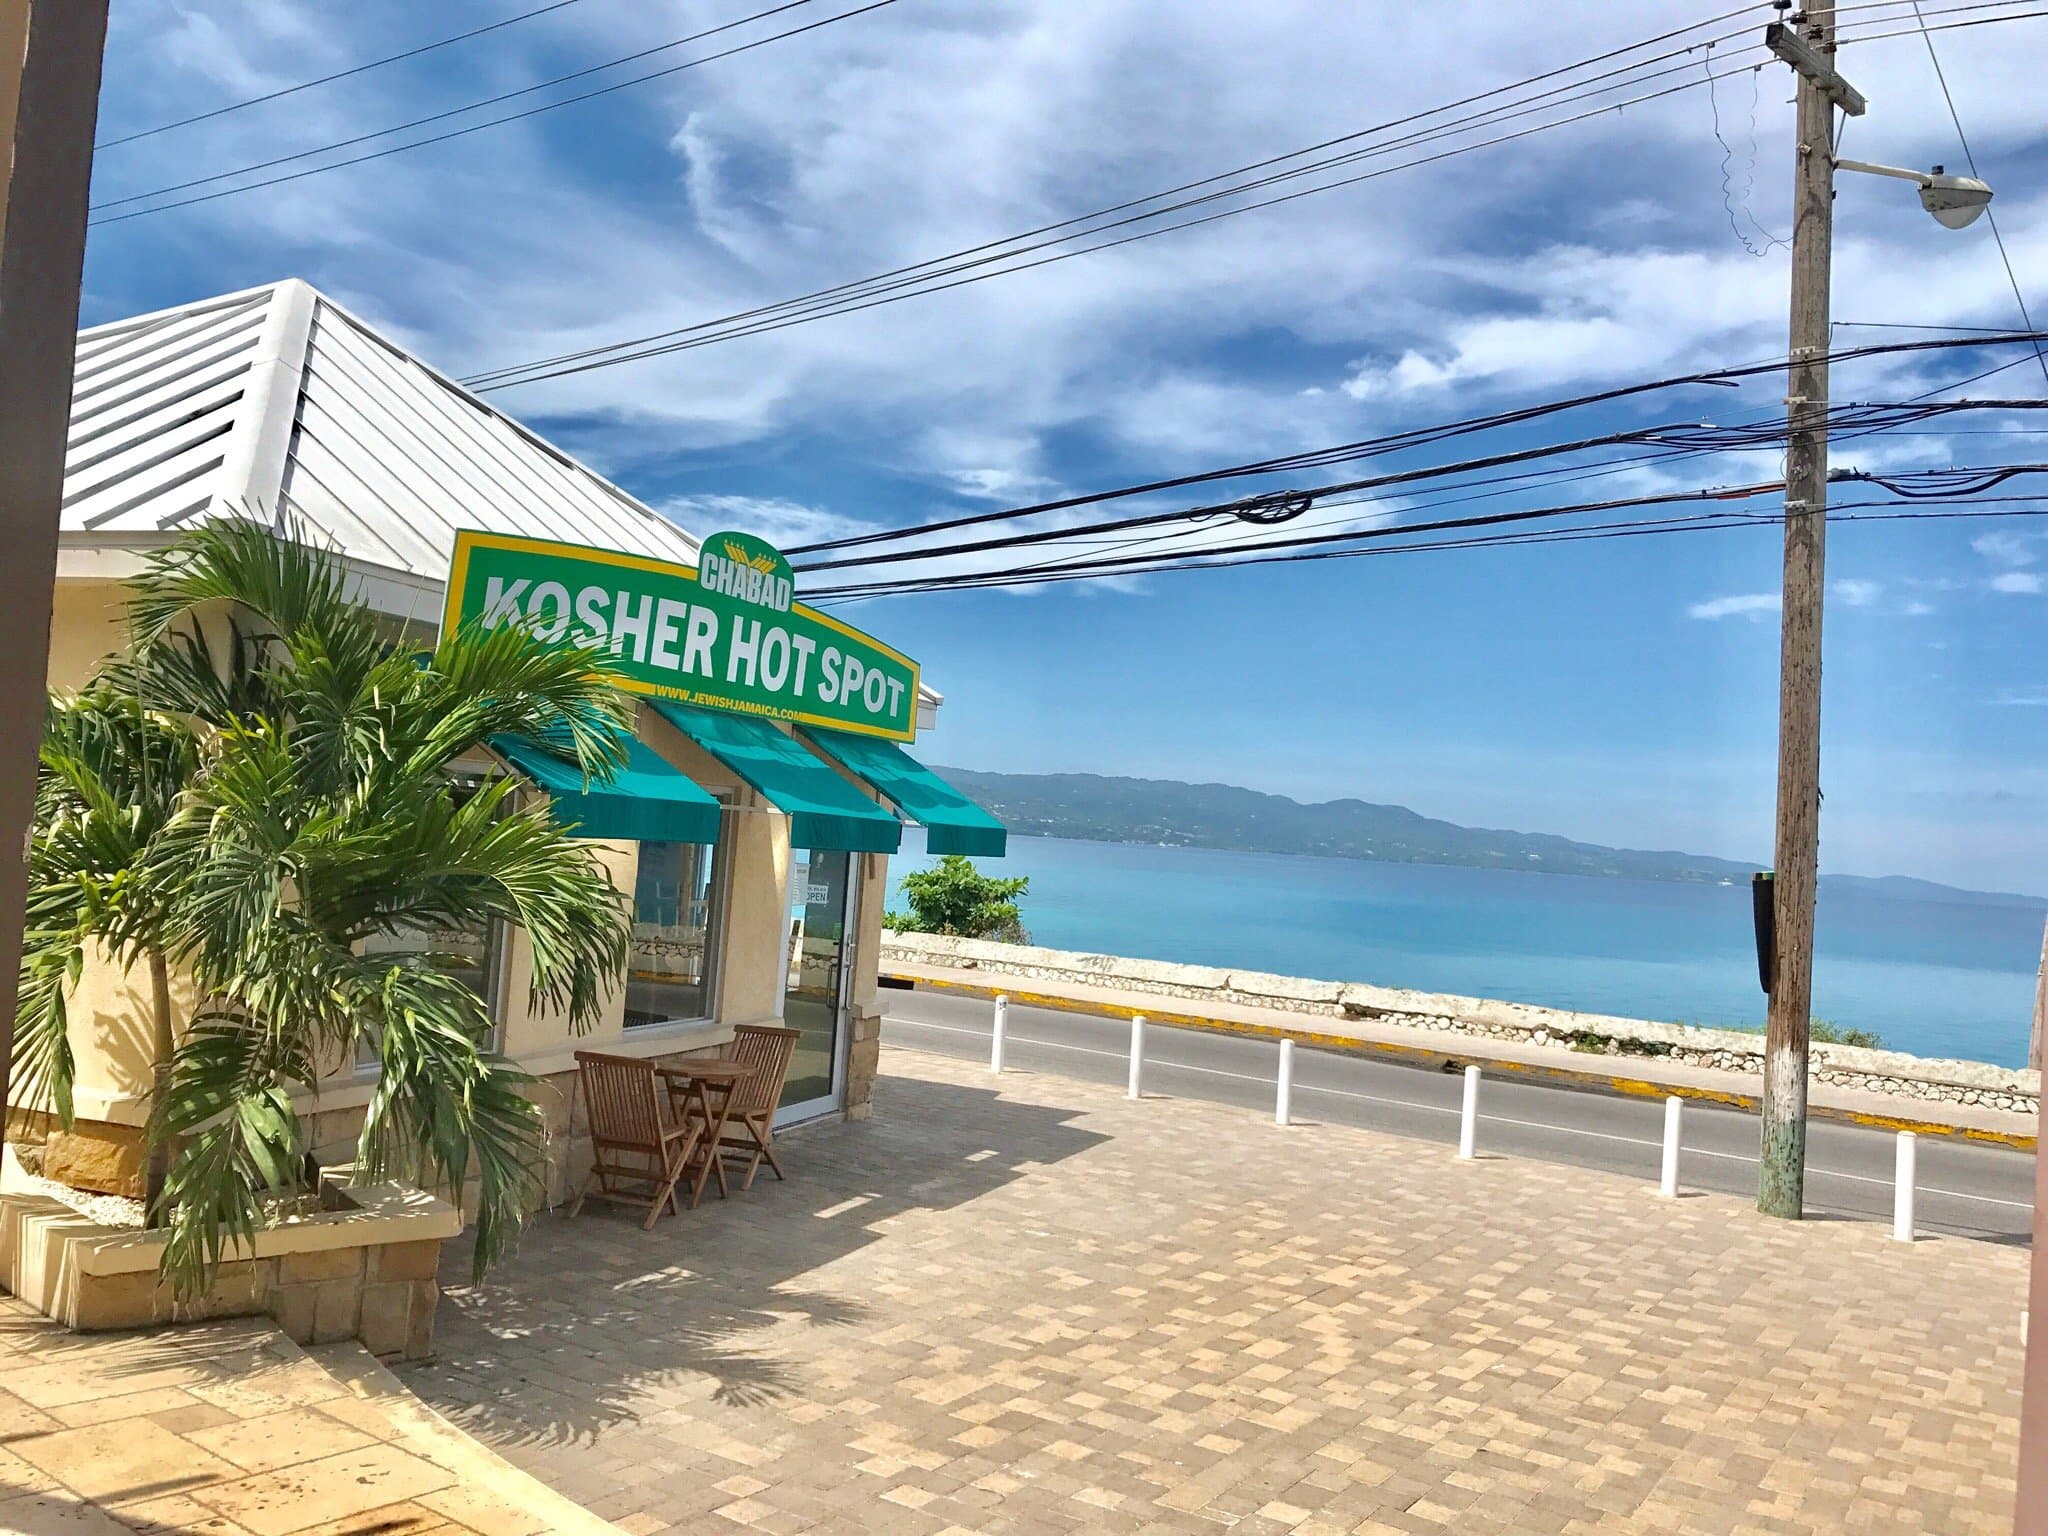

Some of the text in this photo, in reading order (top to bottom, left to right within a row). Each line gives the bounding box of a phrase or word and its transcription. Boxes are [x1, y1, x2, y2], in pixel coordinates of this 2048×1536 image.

[701, 552, 791, 613] CHABAD
[481, 576, 905, 718] KOSHER HOT SPOT
[655, 684, 802, 721] WWW.JEWISHJAMAICA.COM
